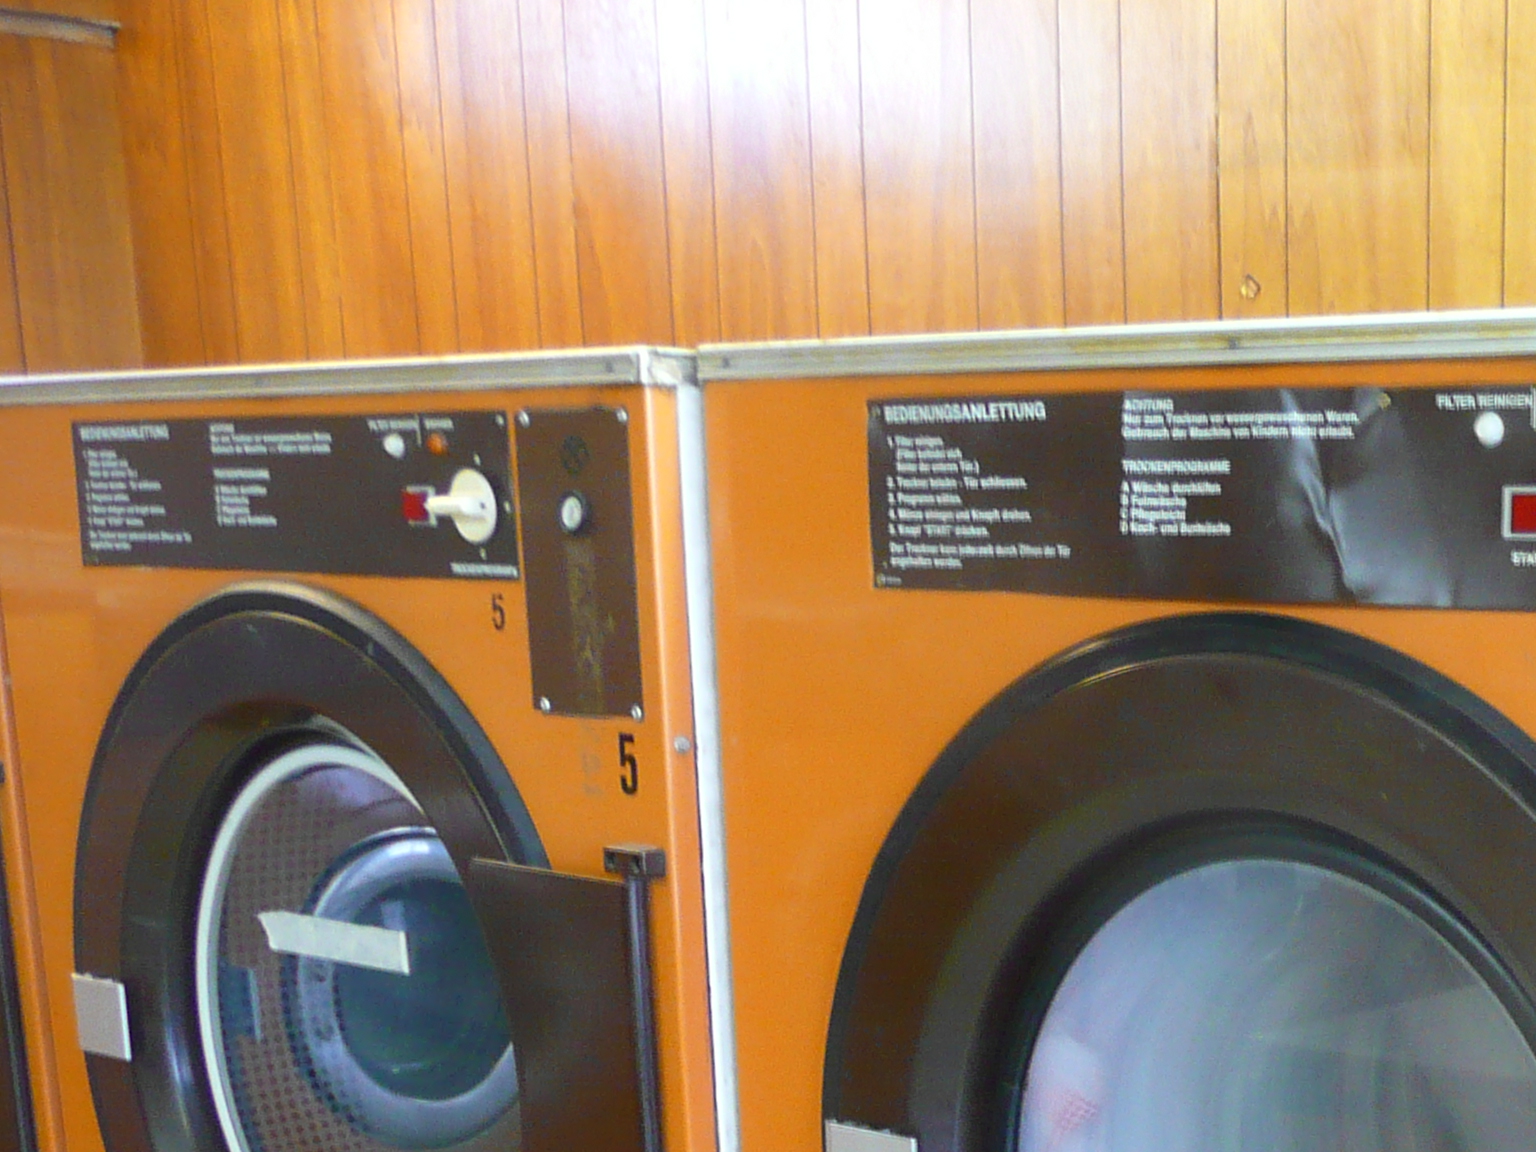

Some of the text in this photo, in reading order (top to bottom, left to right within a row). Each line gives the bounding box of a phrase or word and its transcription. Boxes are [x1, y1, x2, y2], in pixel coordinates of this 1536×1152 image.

[1435, 392, 1476, 410] FILTER
[491, 593, 505, 630] 5
[618, 732, 638, 795] 5
